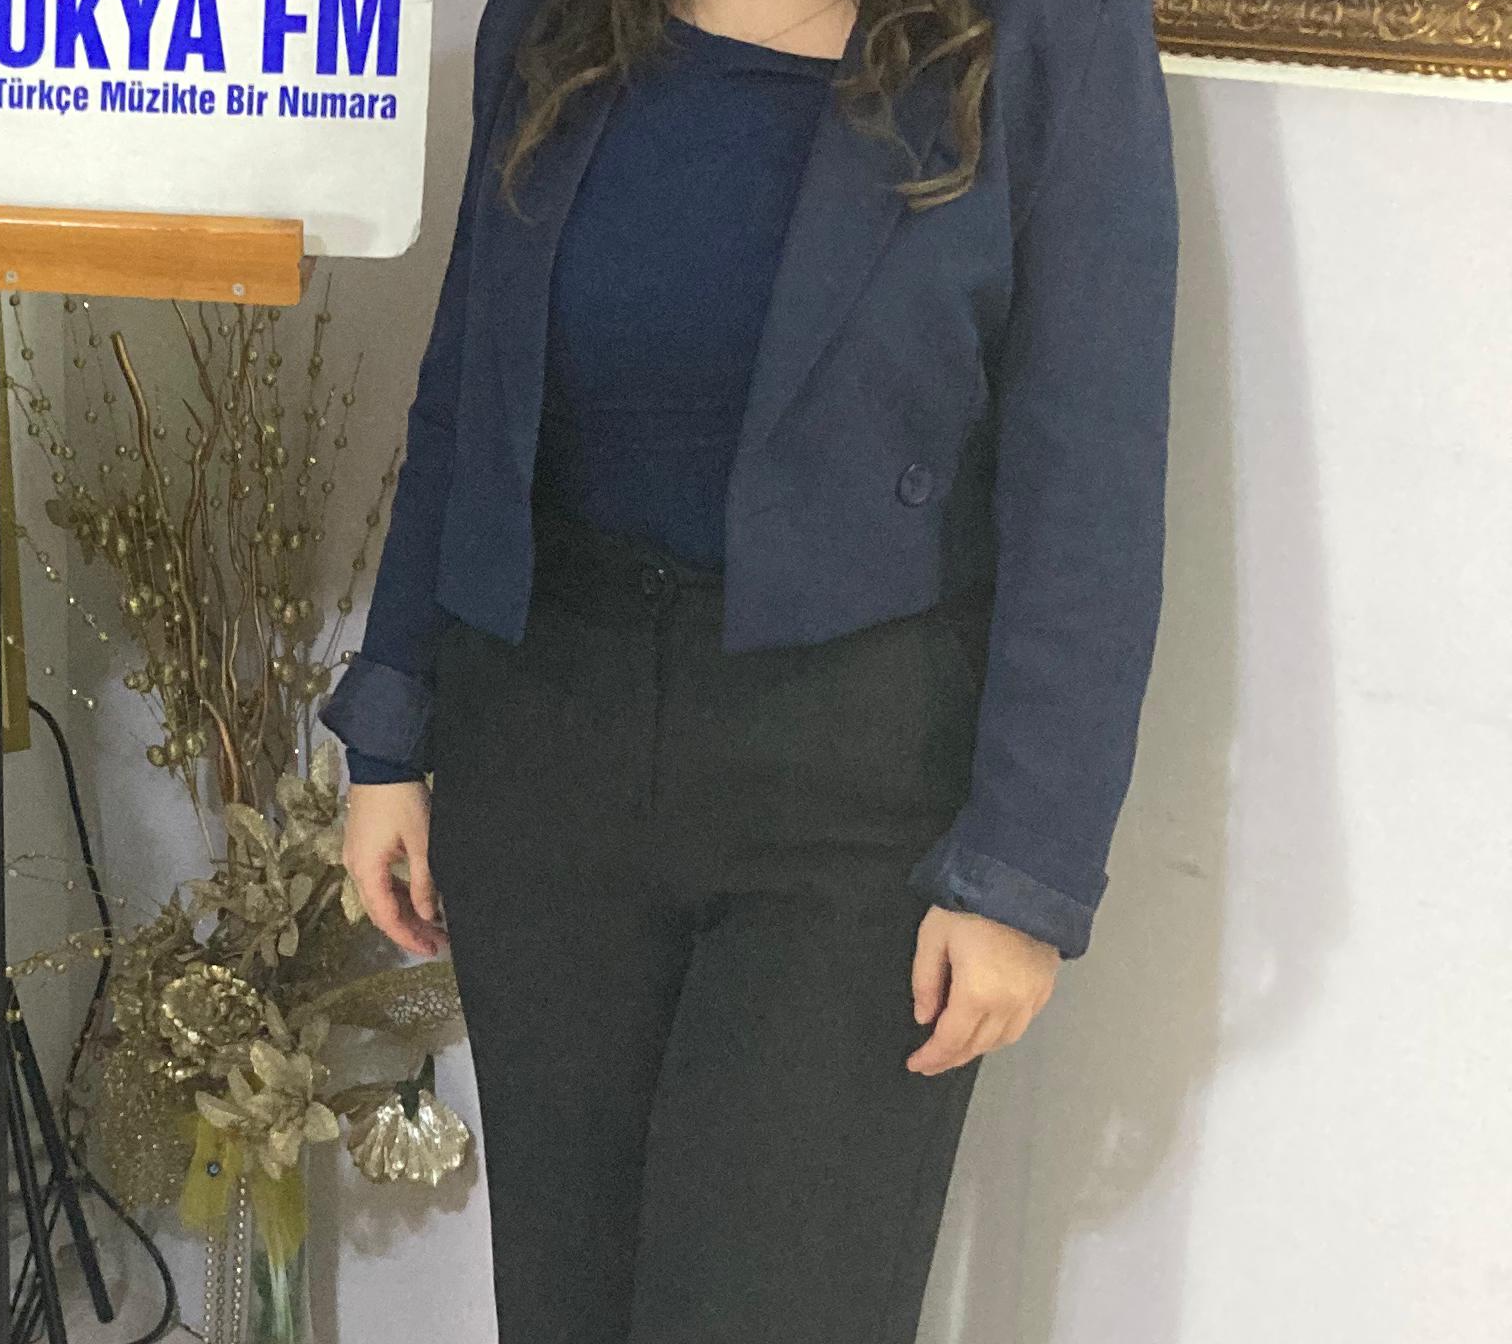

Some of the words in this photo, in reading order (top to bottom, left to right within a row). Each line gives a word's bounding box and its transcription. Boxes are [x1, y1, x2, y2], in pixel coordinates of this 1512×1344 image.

[100, 80, 216, 115] Müzikte
[226, 84, 269, 117] Bir
[278, 85, 398, 120] Numara
